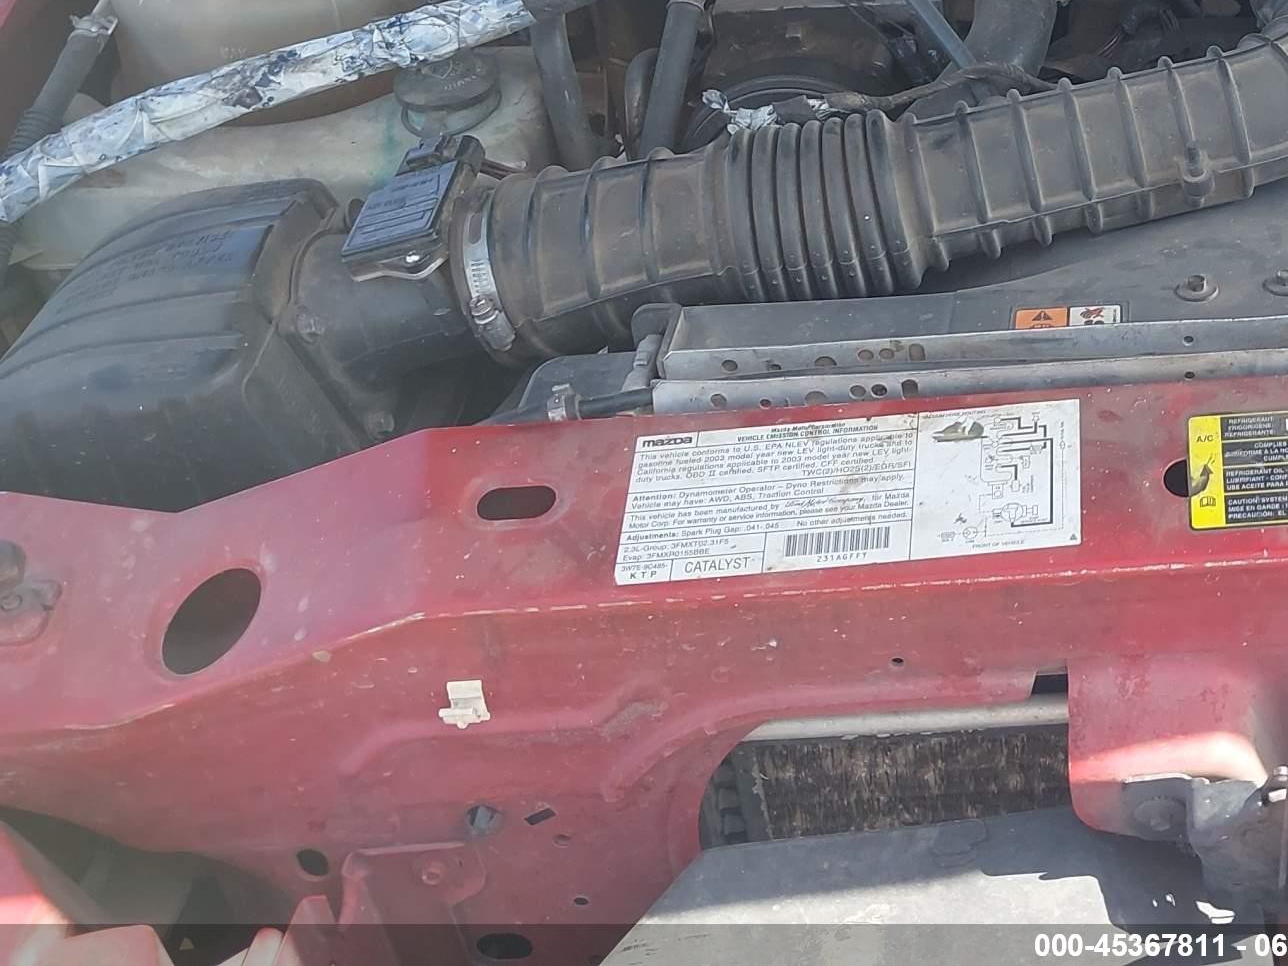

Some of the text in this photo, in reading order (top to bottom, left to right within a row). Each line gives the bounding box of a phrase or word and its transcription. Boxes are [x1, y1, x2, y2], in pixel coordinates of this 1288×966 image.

[642, 436, 692, 447] mazda
[766, 431, 798, 439] EMISSION
[800, 428, 829, 436] CONTROL
[832, 424, 877, 433] INFORMATION
[1196, 434, 1213, 442] A/C
[637, 459, 672, 469] gasoline
[727, 452, 753, 460] model
[817, 443, 855, 454] light-duty
[691, 447, 729, 456] conforms
[811, 436, 857, 447] regulations
[637, 466, 676, 475] California
[677, 462, 723, 473] regulations
[726, 458, 768, 469] applicable
[781, 455, 801, 463] 2003
[804, 453, 829, 461] model
[634, 475, 652, 484] duty
[678, 487, 736, 500] Dynamometer
[738, 484, 775, 494] Operator
[785, 481, 807, 490] Dyno
[809, 477, 857, 486] Restrictions
[860, 476, 880, 484] may
[630, 502, 661, 510] Vehicle
[663, 501, 680, 509] may
[758, 490, 791, 498] Traction
[793, 487, 823, 495] Control
[648, 512, 675, 520] vehicle
[694, 508, 713, 516] been
[715, 504, 767, 514] manufactured
[770, 503, 779, 511] by
[884, 491, 909, 499] Mazda
[680, 529, 702, 538] Spark
[704, 527, 721, 536] Plug
[830, 514, 875, 525] adjustments
[686, 516, 716, 526] warranty
[799, 507, 822, 516] please
[684, 556, 750, 573] CATALYST
